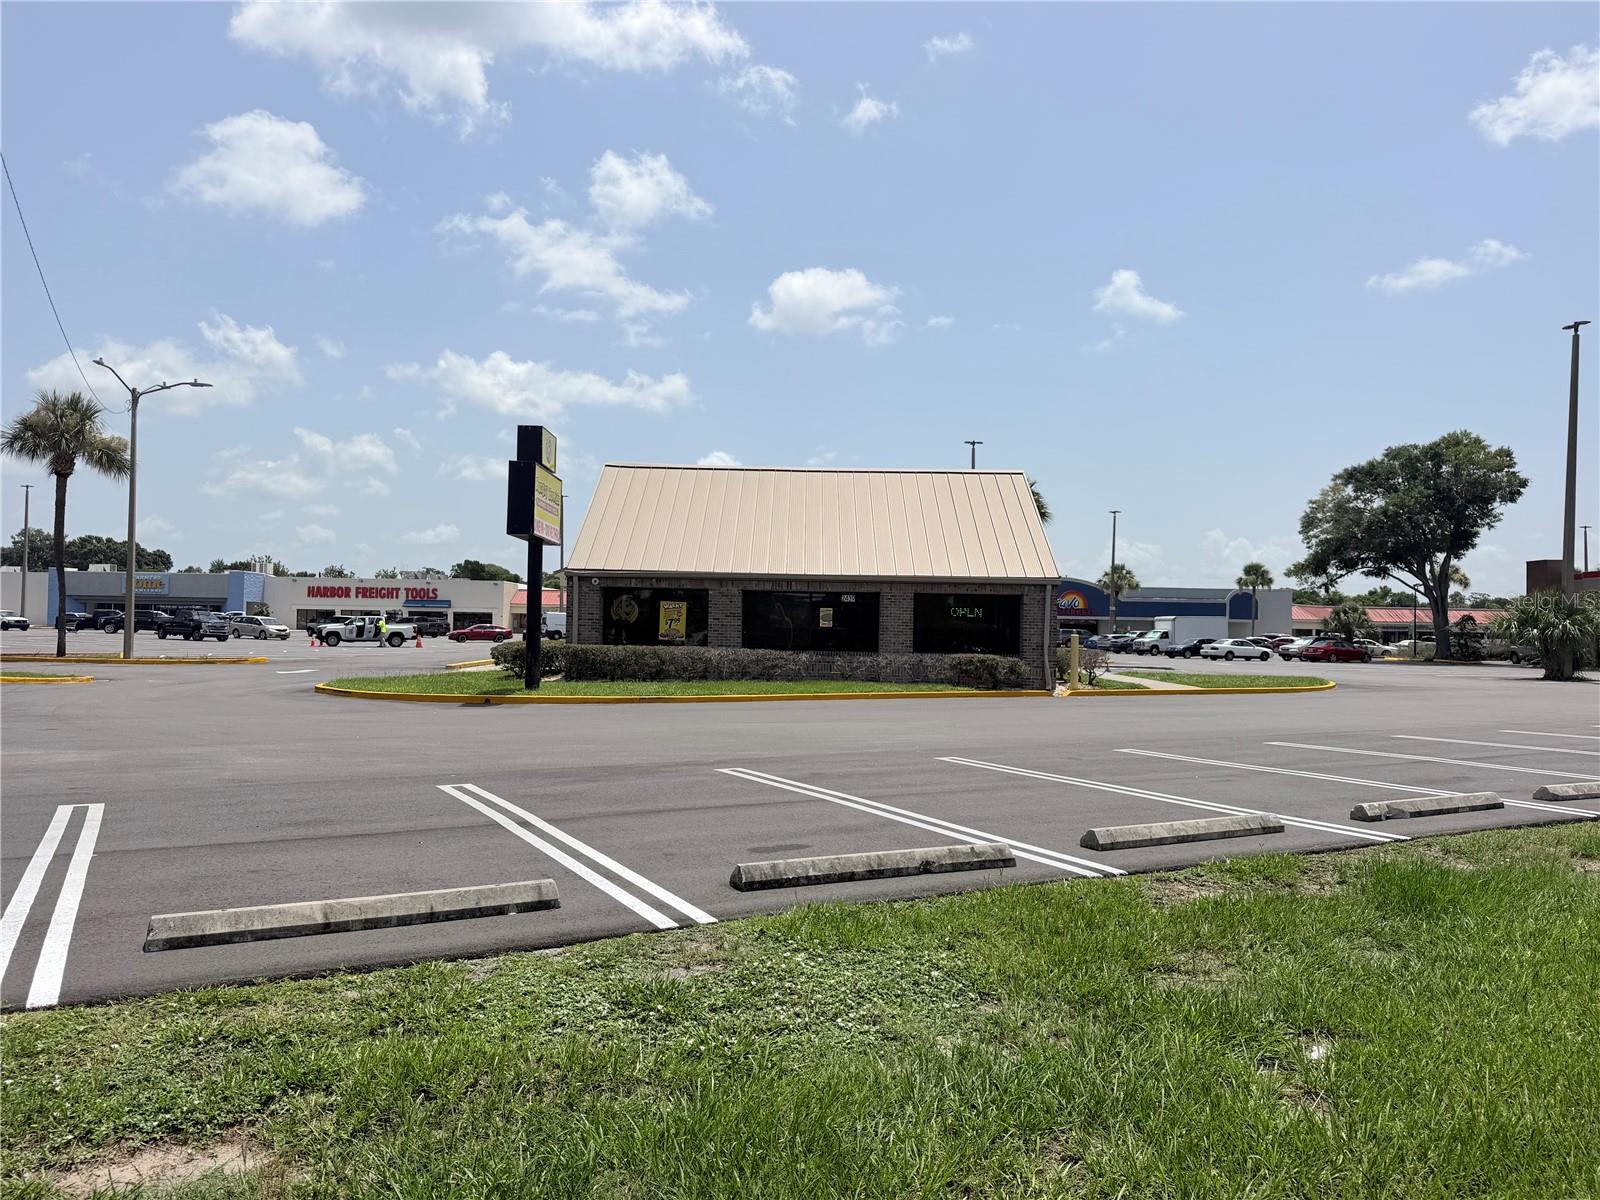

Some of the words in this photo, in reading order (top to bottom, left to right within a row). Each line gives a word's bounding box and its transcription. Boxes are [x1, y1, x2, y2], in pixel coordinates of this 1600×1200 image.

[307, 586, 352, 598] HARBOR
[355, 587, 401, 599] FREIGHT
[404, 588, 439, 599] TOOLS
